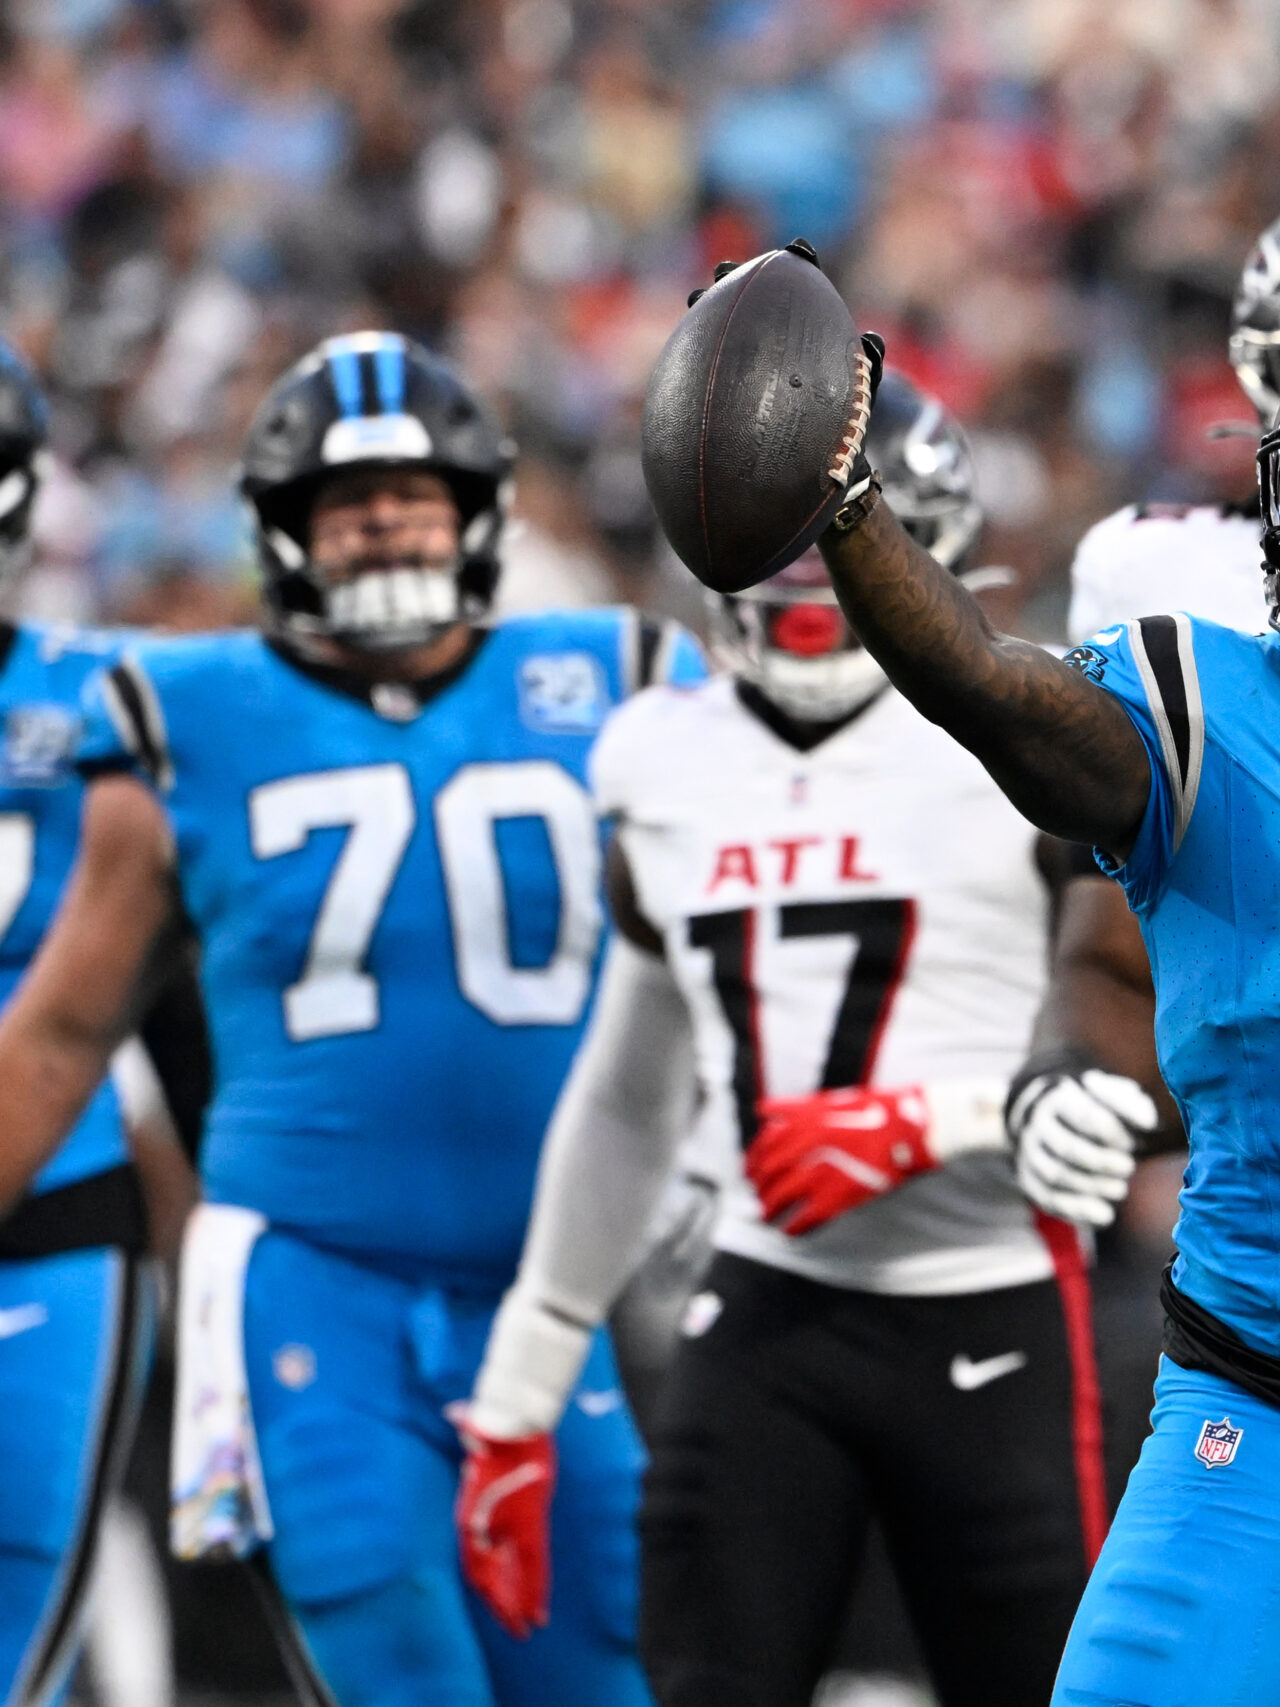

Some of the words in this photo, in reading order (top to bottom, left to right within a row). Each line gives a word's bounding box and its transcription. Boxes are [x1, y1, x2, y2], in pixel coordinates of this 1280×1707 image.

[249, 761, 603, 1043] 70
[706, 835, 880, 895] ATL
[686, 897, 919, 1153] 17
[1201, 1438, 1229, 1460] NFL
